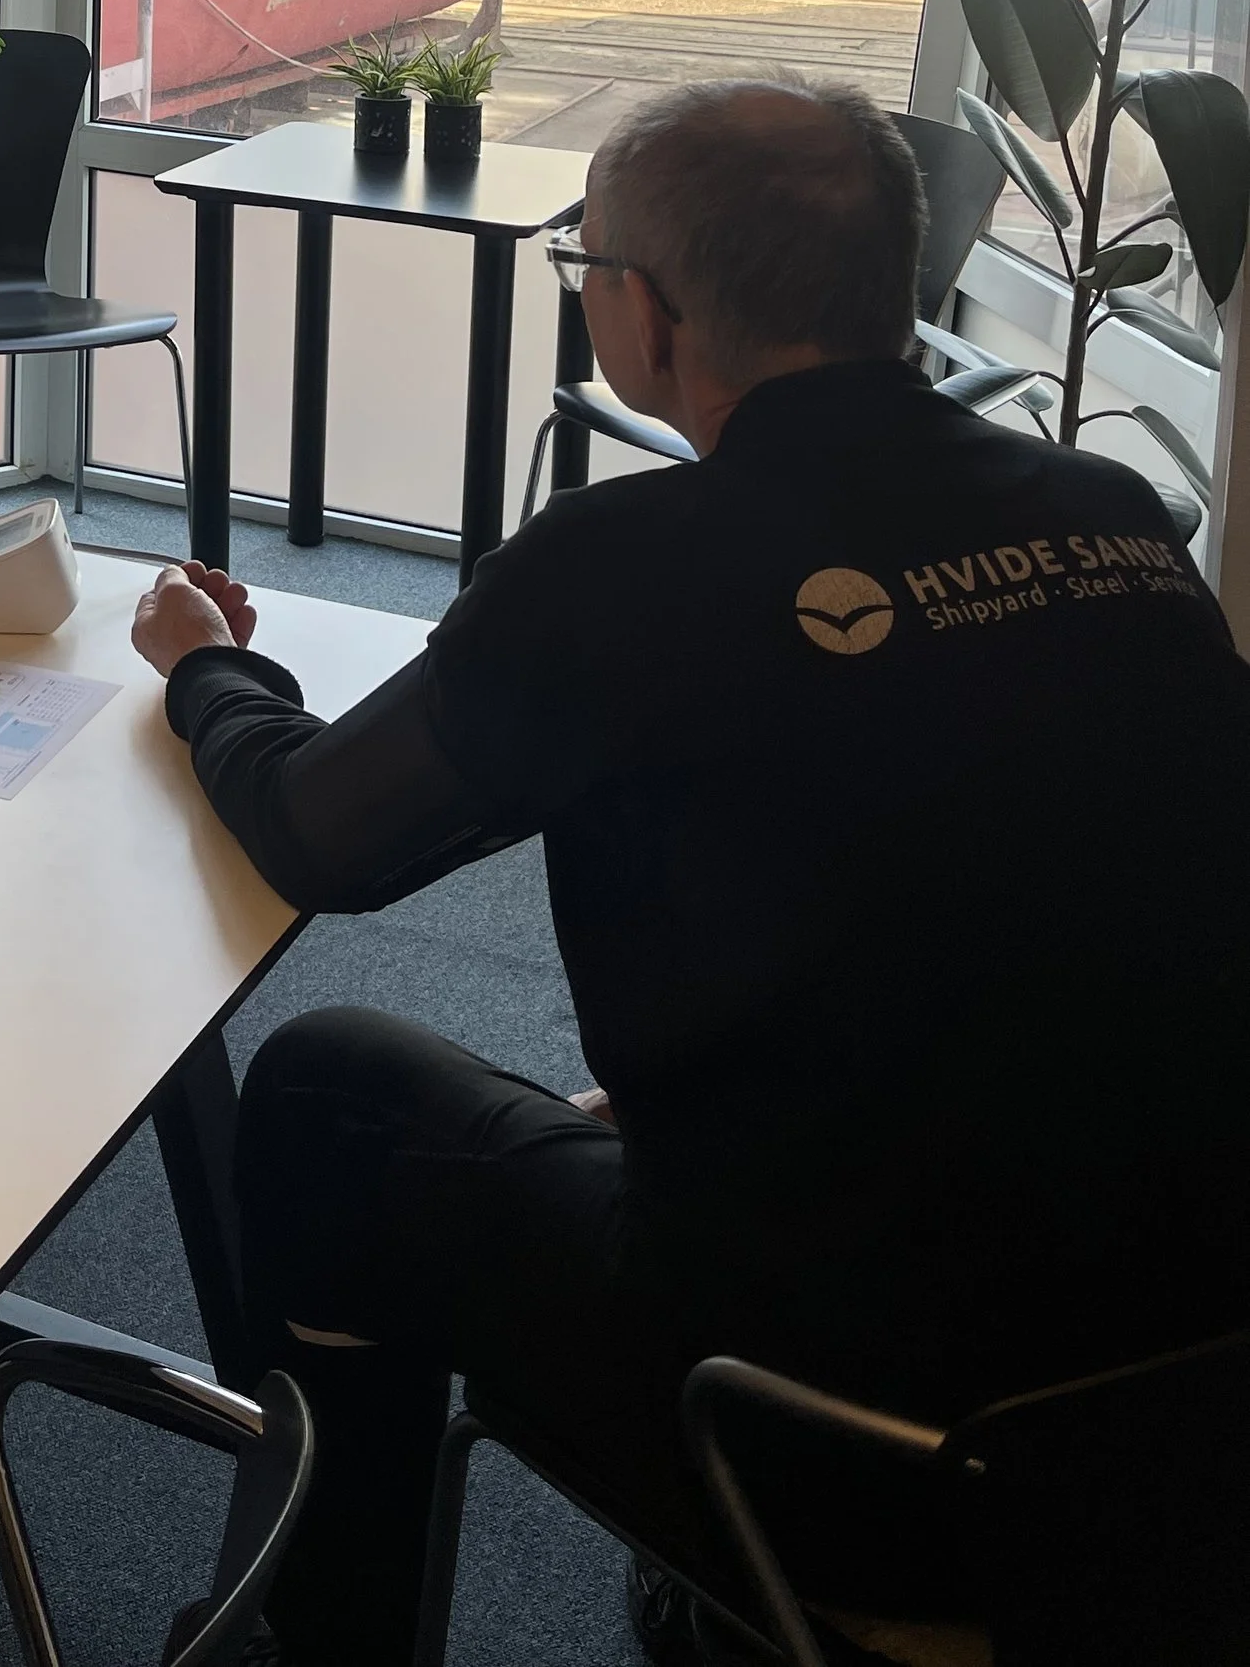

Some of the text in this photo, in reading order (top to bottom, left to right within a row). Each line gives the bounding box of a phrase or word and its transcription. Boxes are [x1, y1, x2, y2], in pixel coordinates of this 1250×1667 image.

[903, 535, 1183, 604] HVIDE SANDE
[925, 581, 1048, 631] Shipyard
[1066, 571, 1131, 599] Steel
